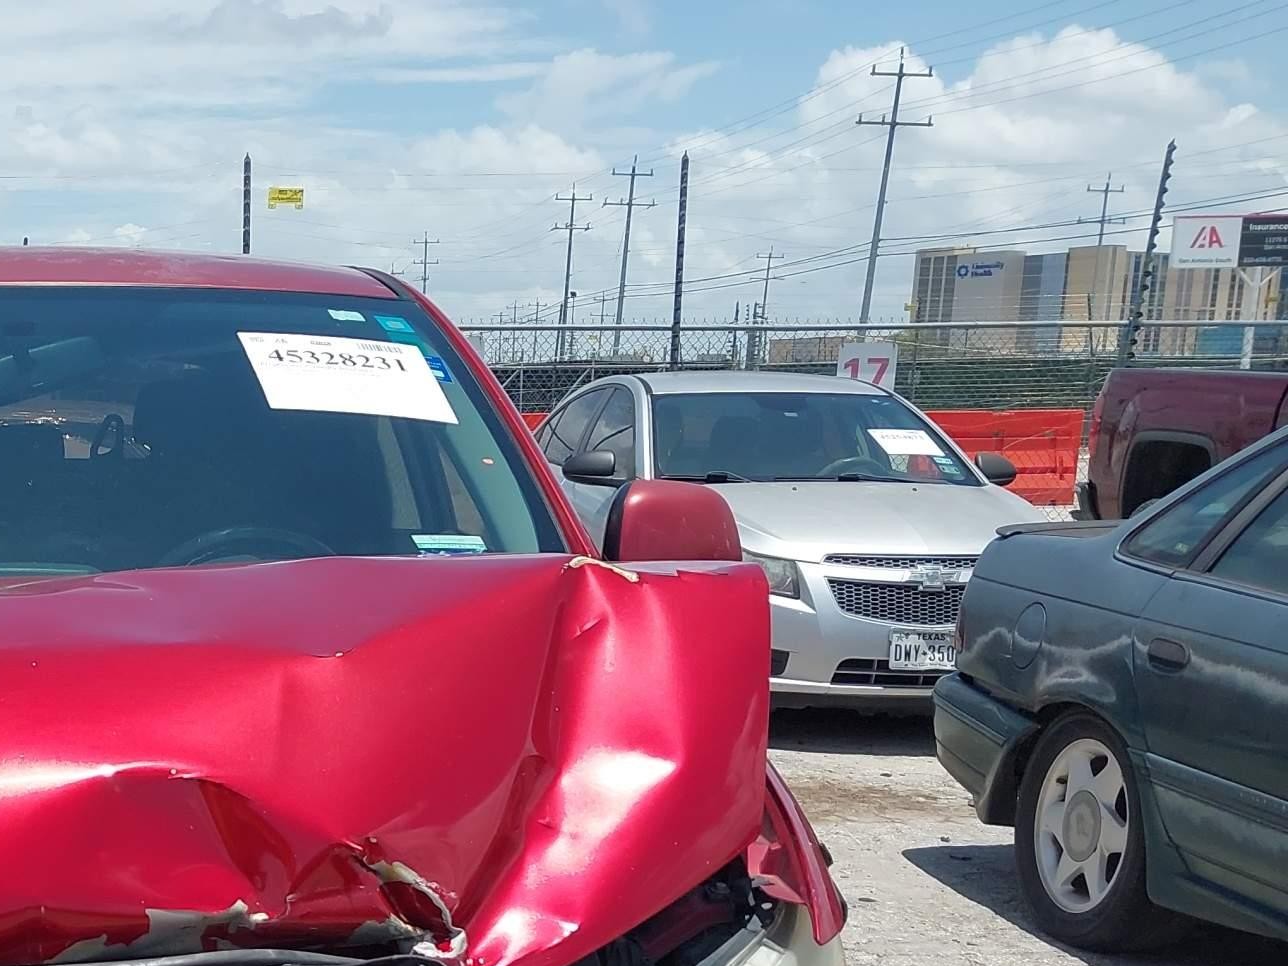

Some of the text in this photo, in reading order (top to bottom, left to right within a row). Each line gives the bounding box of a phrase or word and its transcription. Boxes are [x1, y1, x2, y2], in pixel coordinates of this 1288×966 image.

[268, 349, 408, 372] 45328231
[843, 357, 890, 385] 17
[917, 633, 946, 641] TEXAS
